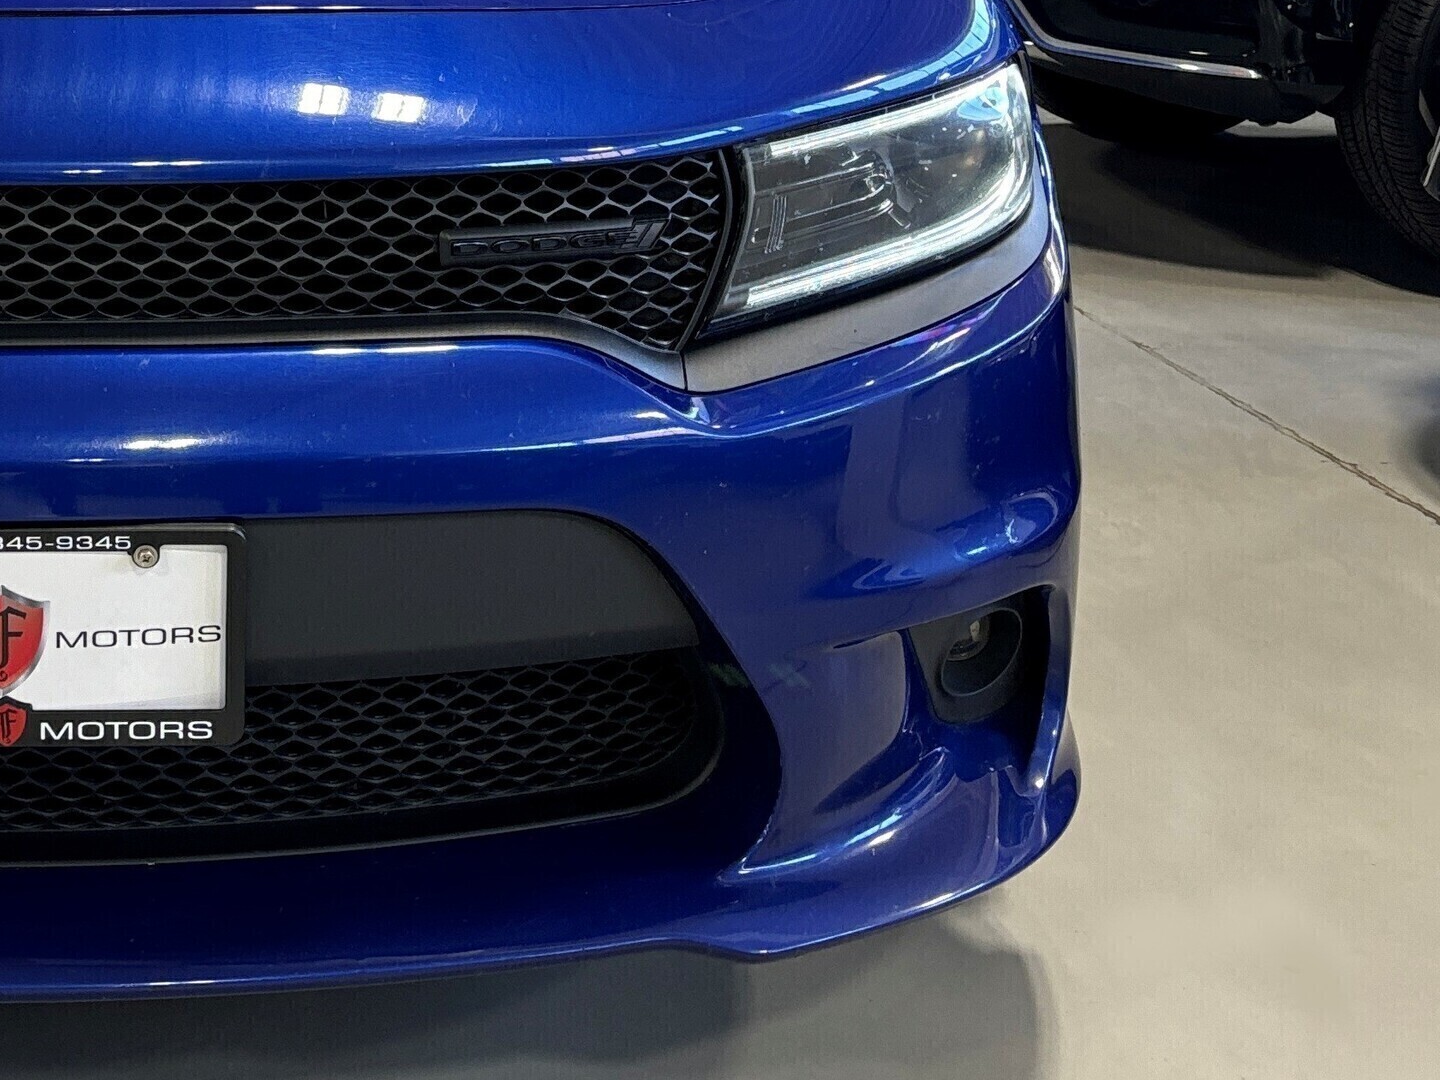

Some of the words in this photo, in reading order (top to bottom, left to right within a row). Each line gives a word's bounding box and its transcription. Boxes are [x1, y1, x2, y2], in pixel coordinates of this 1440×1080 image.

[451, 232, 636, 255] DODGE
[56, 624, 222, 649] MOTORS
[40, 720, 213, 741] MOTORS
